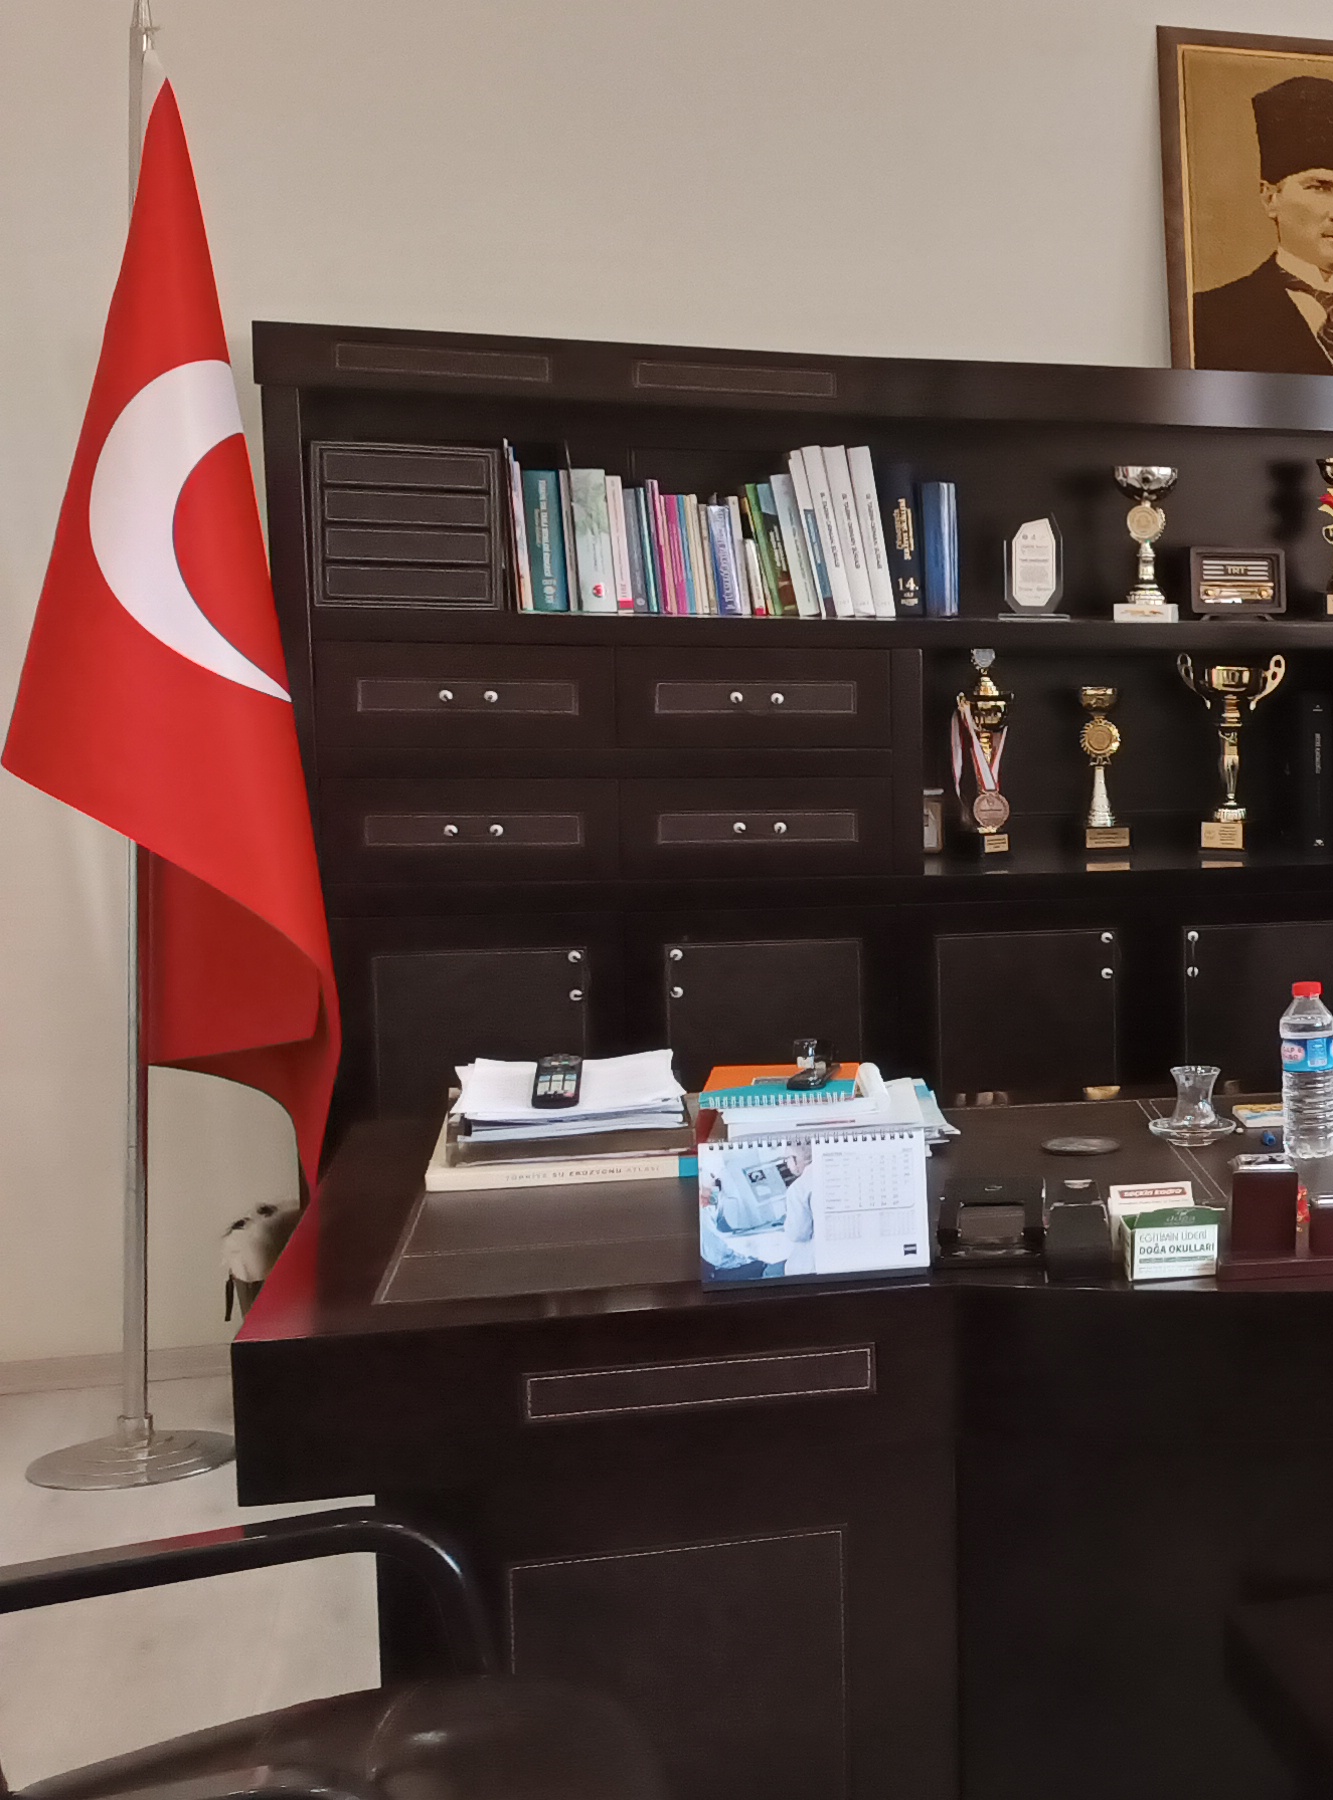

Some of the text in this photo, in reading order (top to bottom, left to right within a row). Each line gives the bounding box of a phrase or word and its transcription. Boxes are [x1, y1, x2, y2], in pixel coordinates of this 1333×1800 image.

[1226, 566, 1247, 574] TRT
[1139, 1242, 1215, 1255] DOĞA OKULLARI
